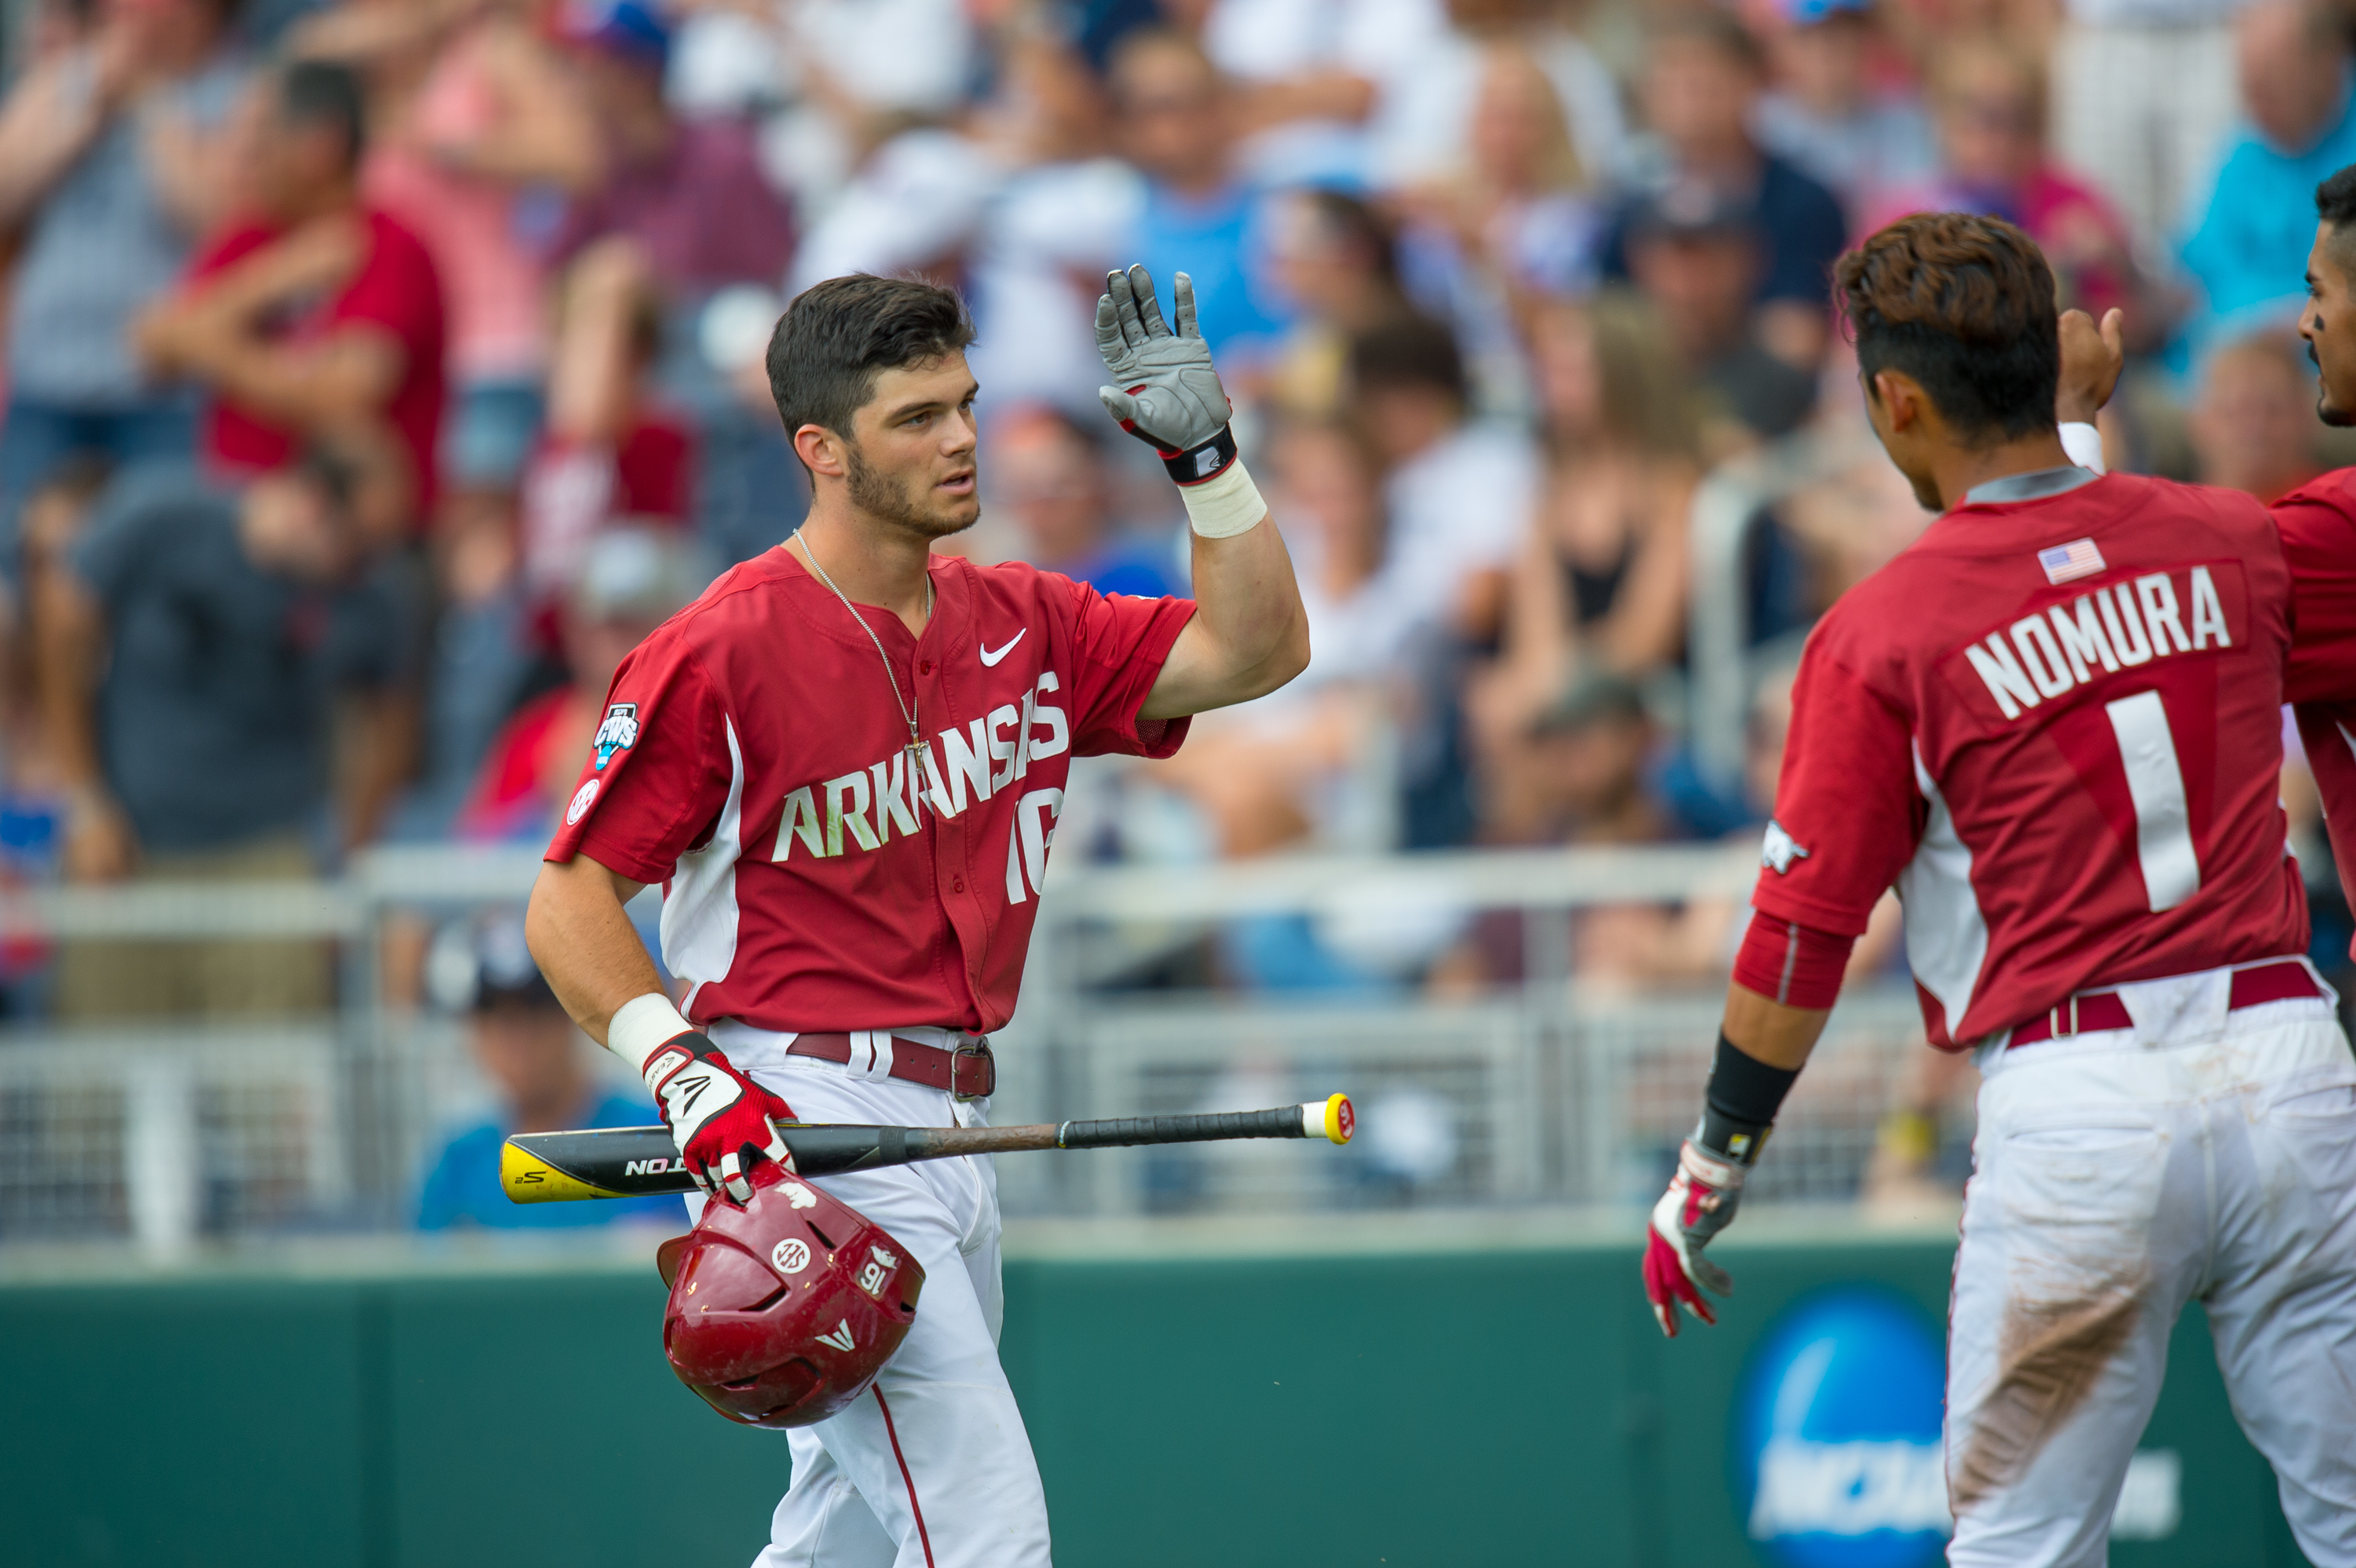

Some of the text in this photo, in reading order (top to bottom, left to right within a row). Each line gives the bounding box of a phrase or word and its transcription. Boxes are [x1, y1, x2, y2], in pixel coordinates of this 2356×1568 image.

[1964, 565, 2232, 720] NOMURA
[594, 715, 638, 747] CWS
[1006, 788, 1063, 905] 16
[2105, 689, 2199, 913] 1
[625, 1157, 688, 1176] TON
